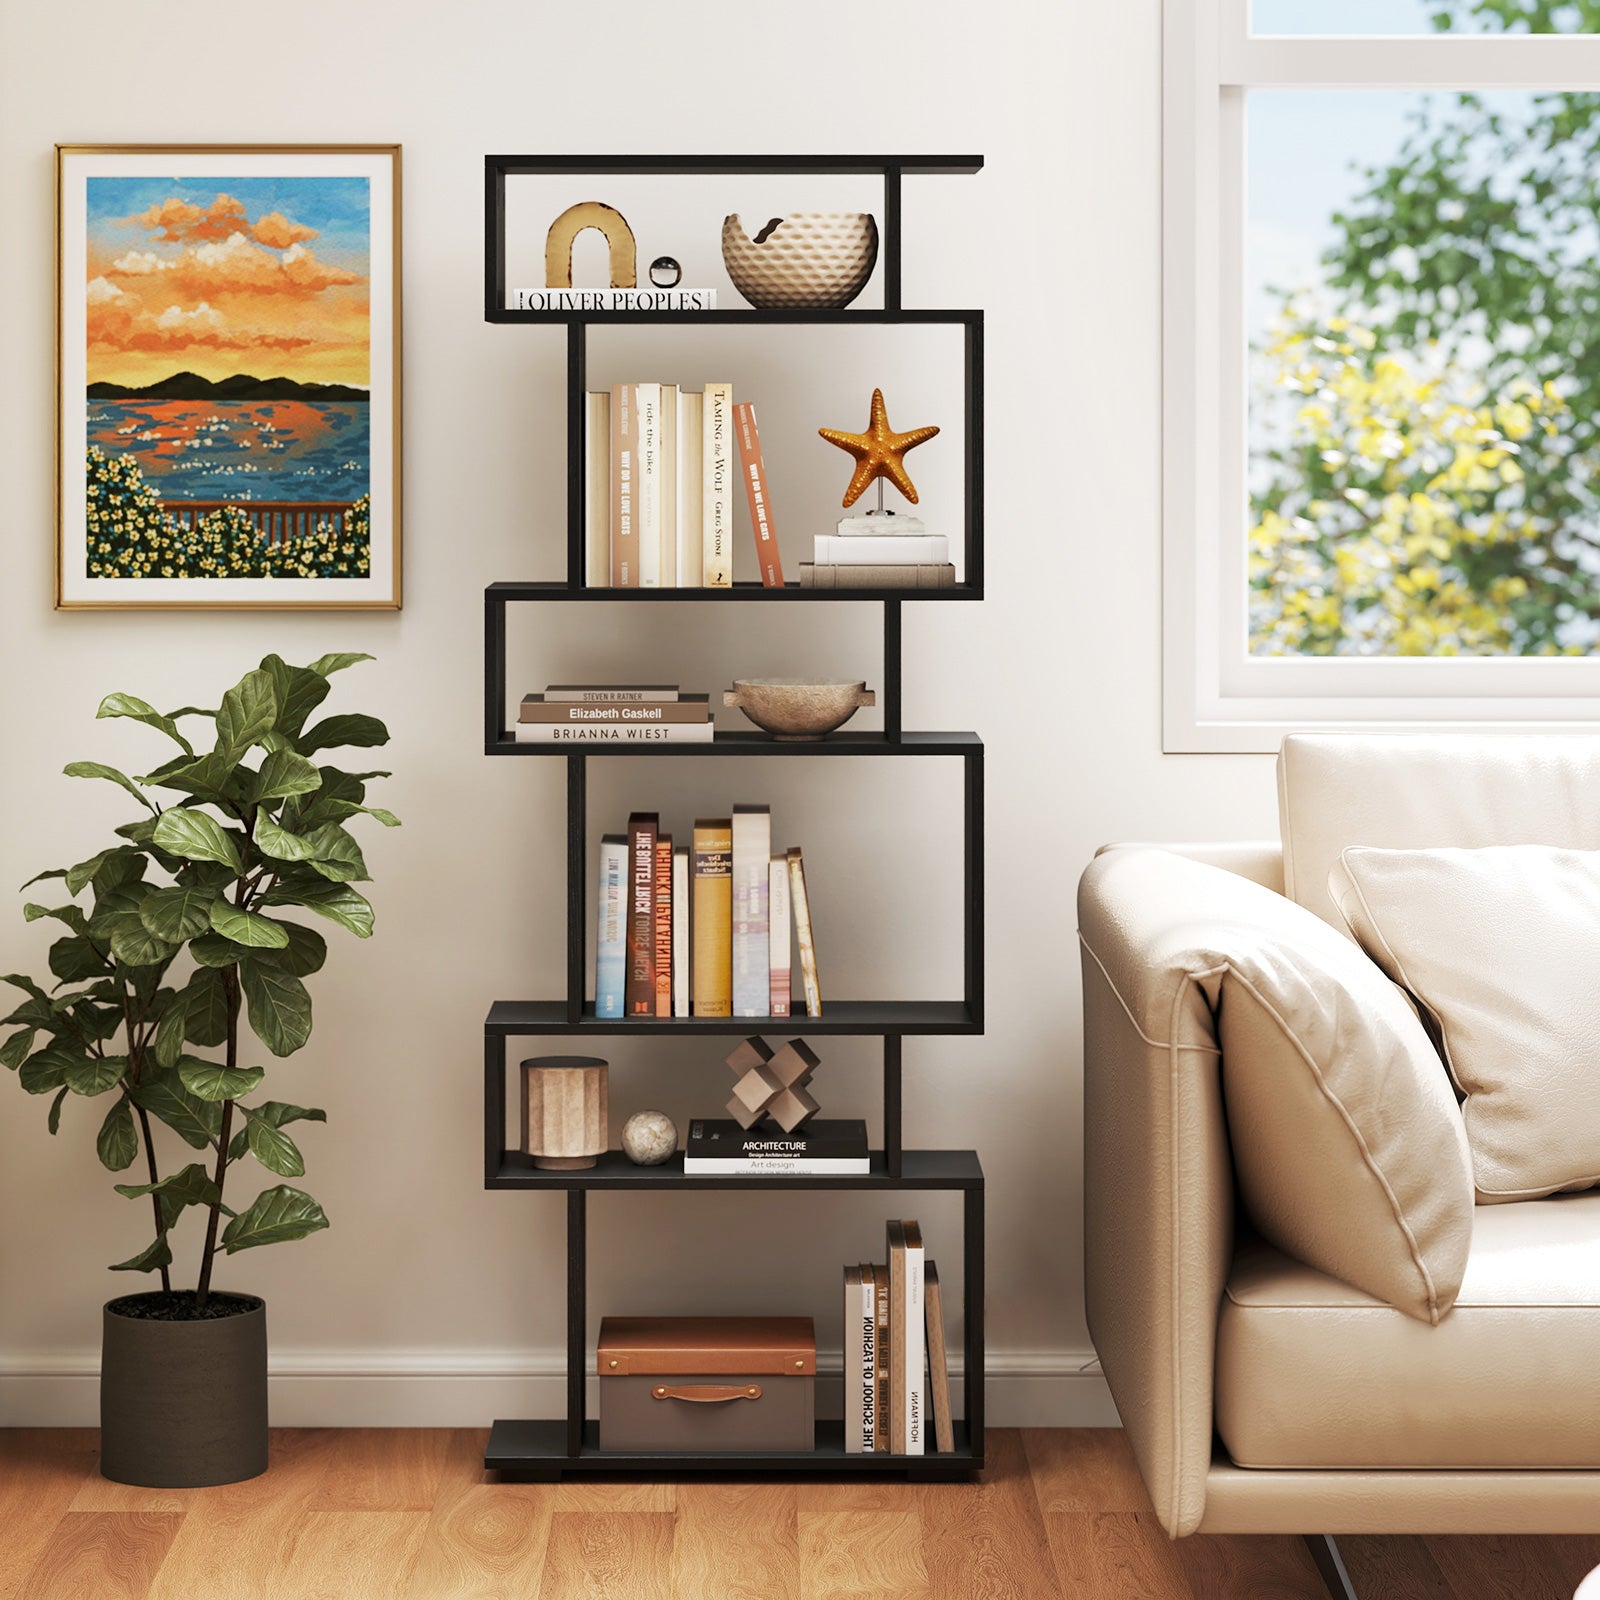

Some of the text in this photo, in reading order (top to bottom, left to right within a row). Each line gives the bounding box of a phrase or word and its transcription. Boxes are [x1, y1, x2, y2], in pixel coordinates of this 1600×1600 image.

[528, 292, 604, 310] OLIVER
[613, 292, 702, 310] PEOPLES
[646, 402, 654, 425] ride
[646, 429, 654, 447] the
[714, 391, 725, 494] TAMING the WOLF
[646, 450, 654, 475] bike
[620, 451, 631, 535] WHY DO WE LOVE CATS
[749, 463, 770, 541] WHY DO WE LOVE CATS
[714, 501, 723, 557] GREG STONE
[583, 692, 643, 701] STEVEN R RATNER
[569, 708, 662, 719] Elizabeth Gaskell
[553, 729, 669, 739] BRIANNA WIEST
[742, 1141, 807, 1150] ARCHITECTURE
[766, 1161, 795, 1169] design
